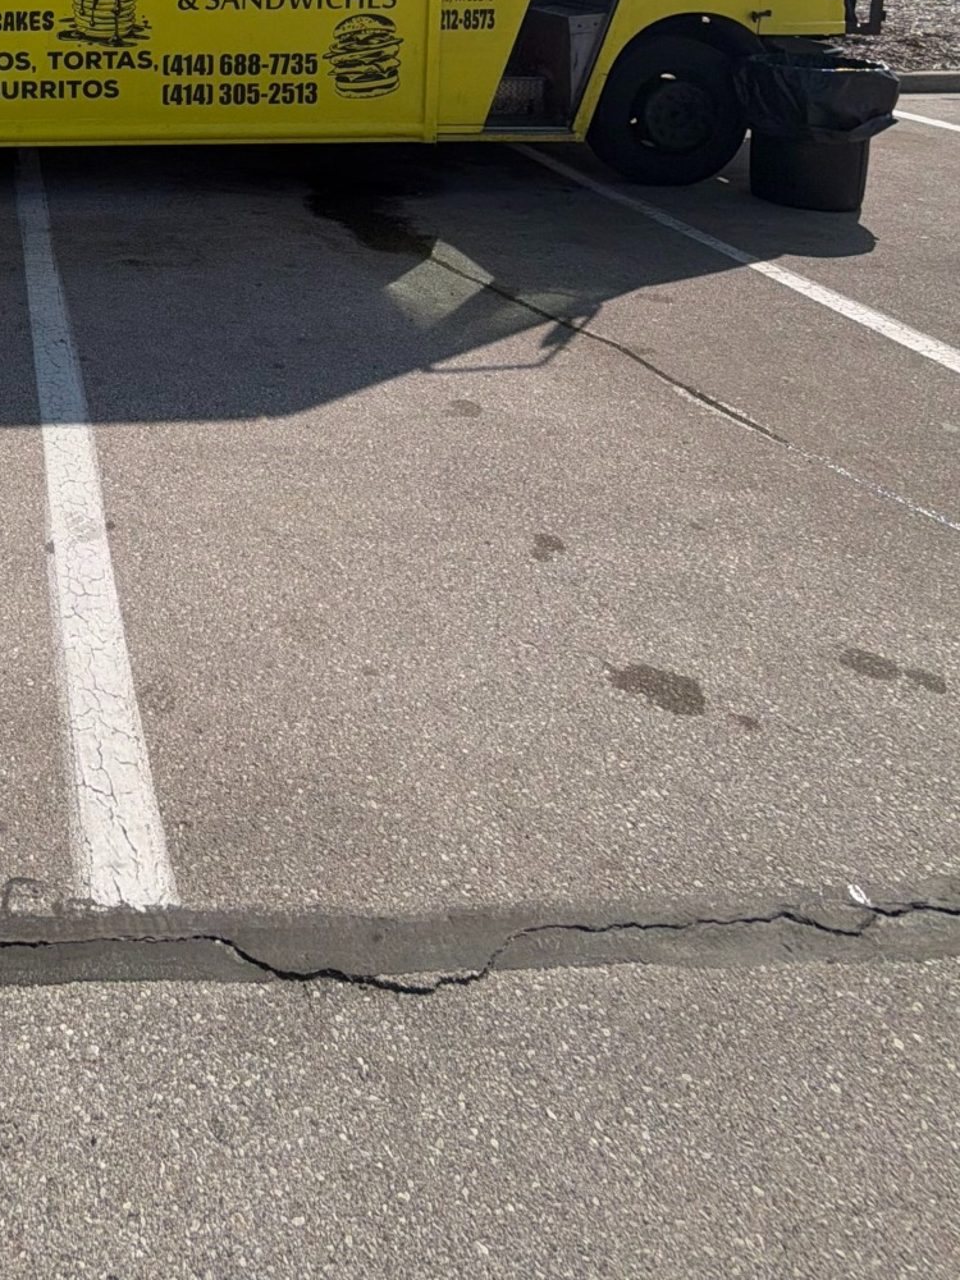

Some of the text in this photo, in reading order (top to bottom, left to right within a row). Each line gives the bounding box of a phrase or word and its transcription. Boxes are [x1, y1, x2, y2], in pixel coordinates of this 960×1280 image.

[47, 50, 159, 72] TORTAS,
[162, 53, 319, 76] (414) 688-7735
[162, 82, 319, 106] (414) 305-2513
